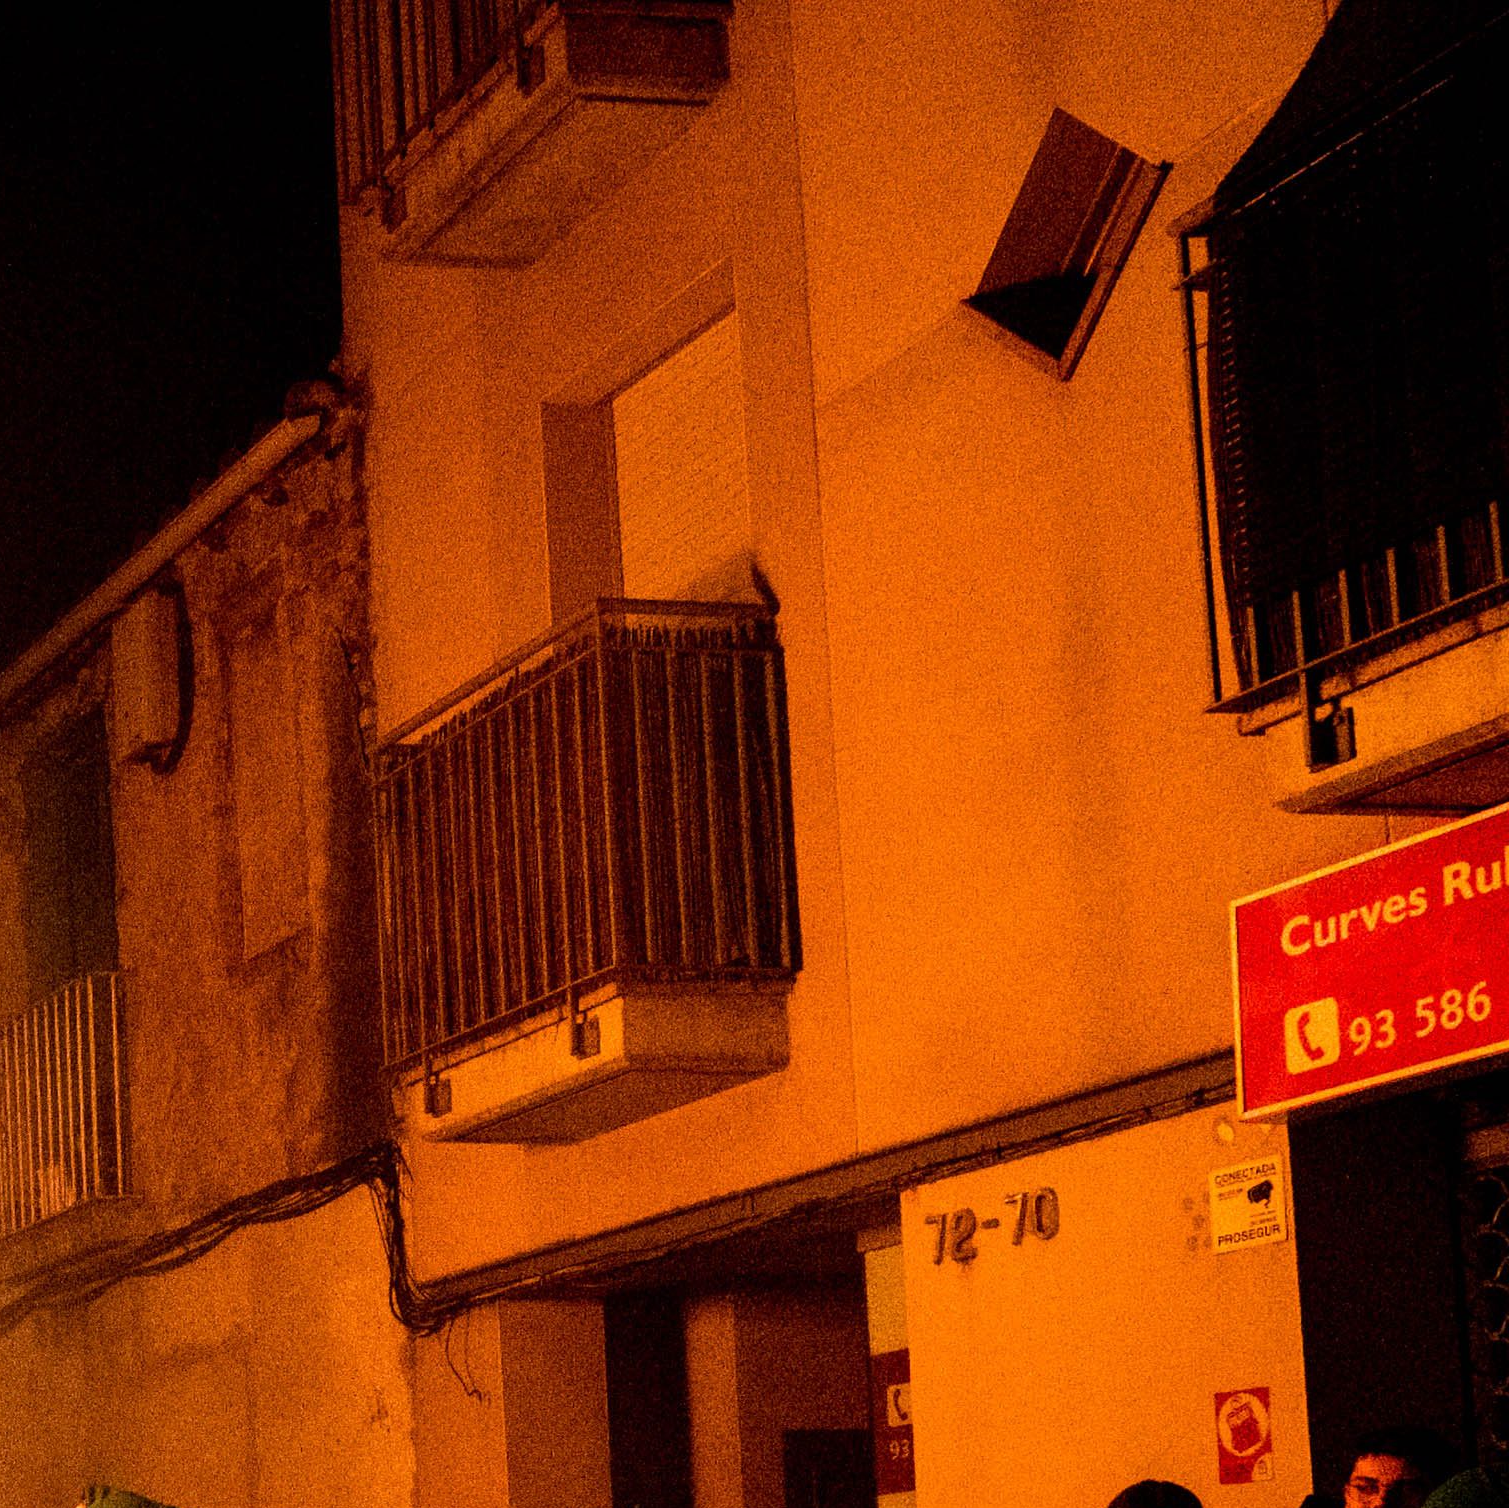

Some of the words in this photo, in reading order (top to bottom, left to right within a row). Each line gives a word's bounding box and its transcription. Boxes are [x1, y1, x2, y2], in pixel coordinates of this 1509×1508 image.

[1280, 886, 1428, 956] Curves
[1443, 844, 1509, 906] Ru
[1348, 1008, 1397, 1056] 93
[1414, 980, 1492, 1038] 586
[1214, 1163, 1277, 1186] CONECTADA
[1218, 1223, 1281, 1247] PROSEGUR
[889, 1439, 910, 1461] 93
